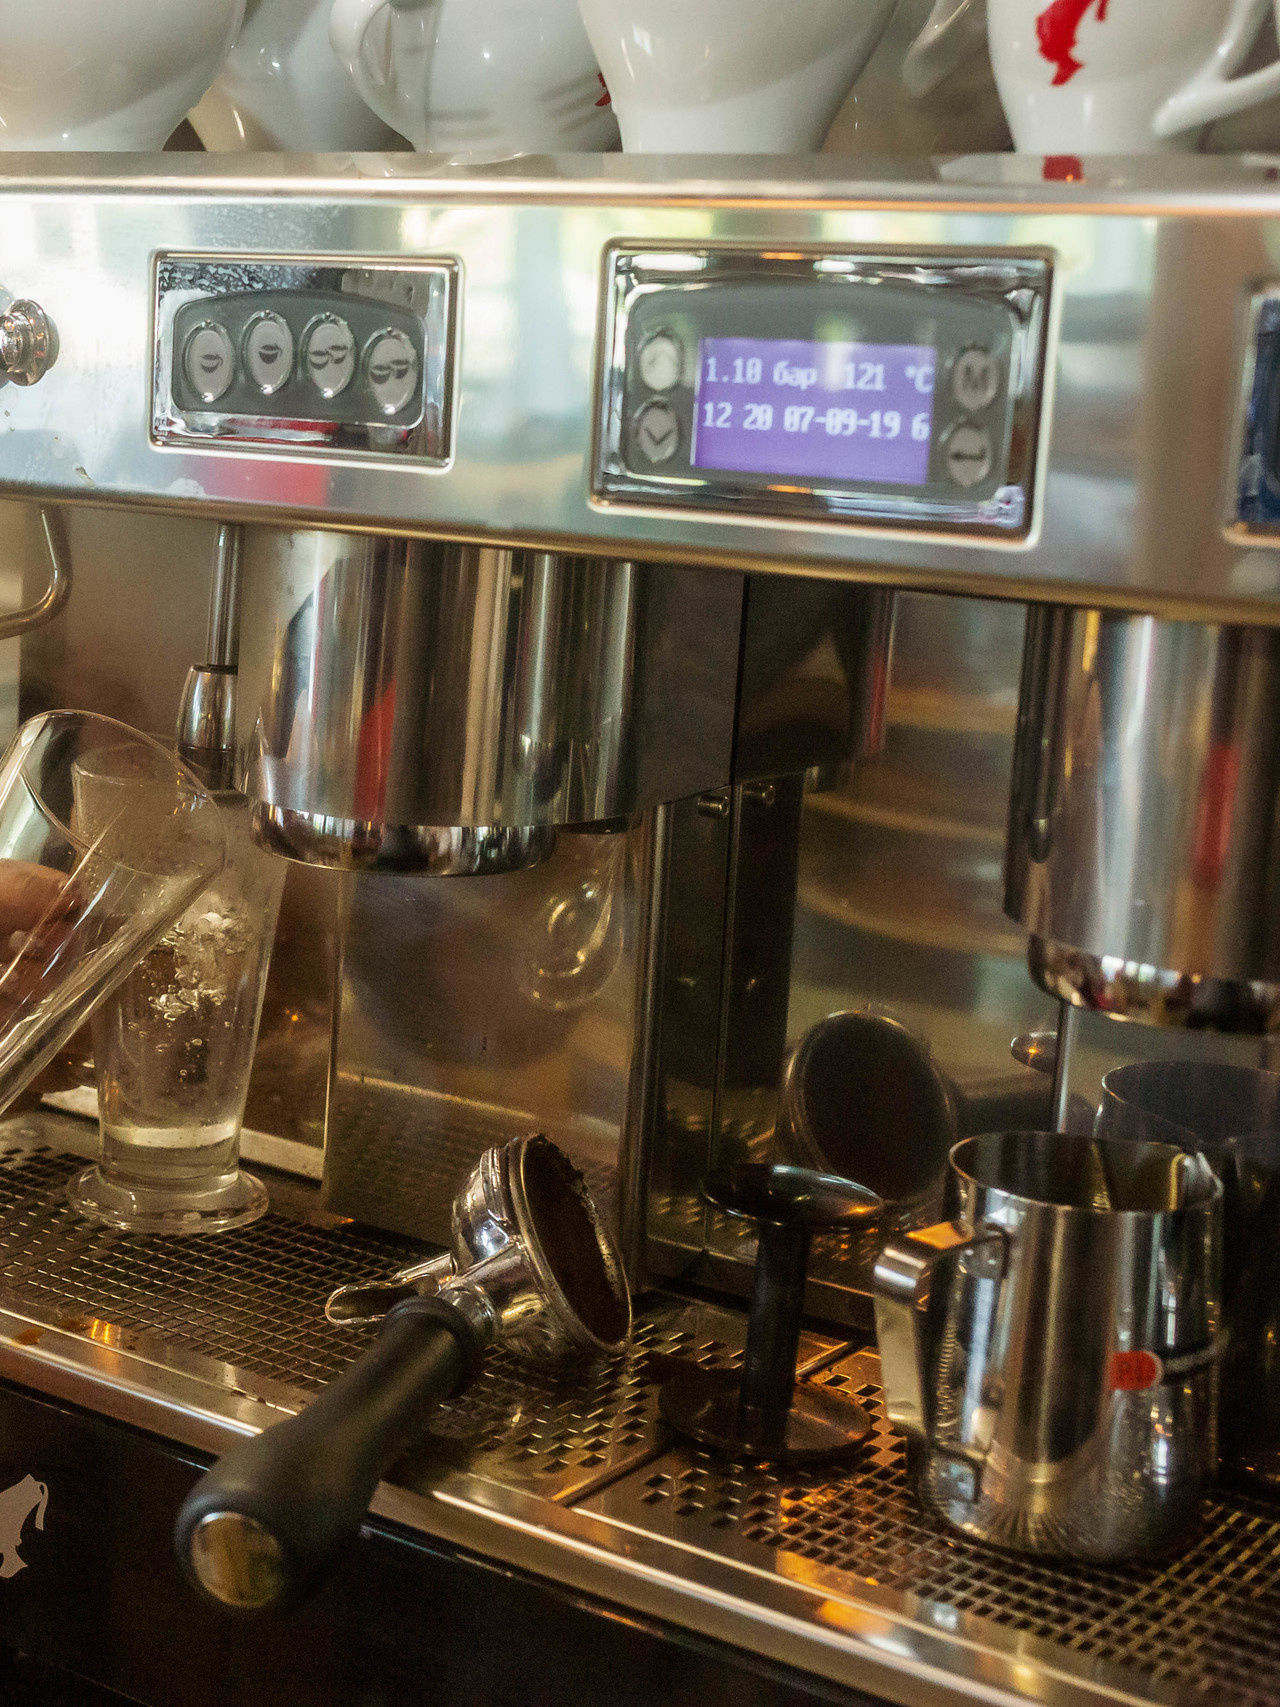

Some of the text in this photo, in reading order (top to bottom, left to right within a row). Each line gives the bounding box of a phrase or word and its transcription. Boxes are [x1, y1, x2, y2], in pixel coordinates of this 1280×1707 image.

[706, 356, 763, 385] 1.10
[772, 360, 818, 391] бар
[844, 361, 887, 392] 121
[702, 401, 733, 429] 12
[783, 405, 901, 440] 07-09-19
[911, 411, 931, 441] 6
